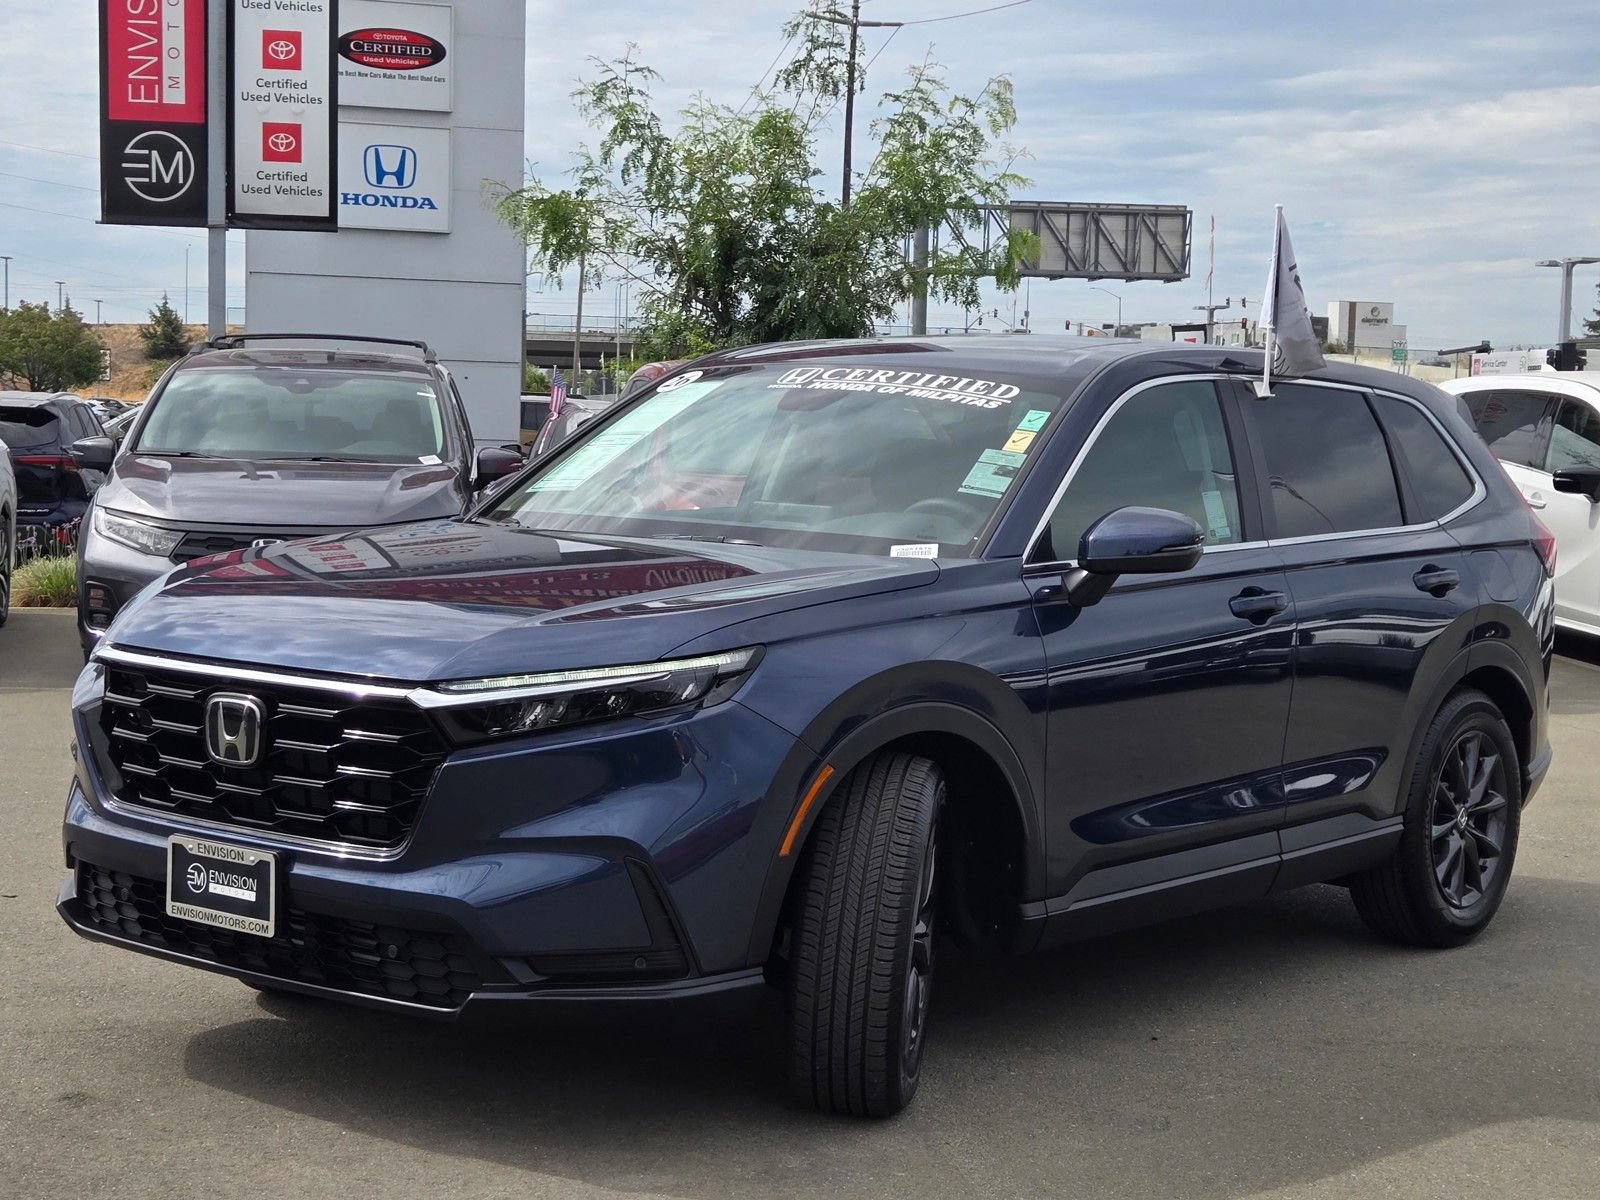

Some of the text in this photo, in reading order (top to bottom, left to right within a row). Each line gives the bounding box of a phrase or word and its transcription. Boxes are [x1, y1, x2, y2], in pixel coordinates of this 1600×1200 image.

[241, 0, 323, 12] Used Vehicles
[350, 40, 432, 56] CERTIFIED
[386, 57, 420, 65] Vehicles
[256, 78, 308, 89] Certified
[241, 92, 323, 105] Used Vehicles
[256, 170, 308, 182] Certified
[241, 184, 323, 197] Used Vehicles
[340, 192, 439, 210] HONDA
[822, 367, 1020, 399] CERTIFIED
[807, 382, 1002, 409] HONDA OF MILPITAS
[198, 843, 245, 861] ENVISION
[209, 869, 257, 891] ENVISION
[171, 904, 269, 935] ENVISIONMOTORS.COM
